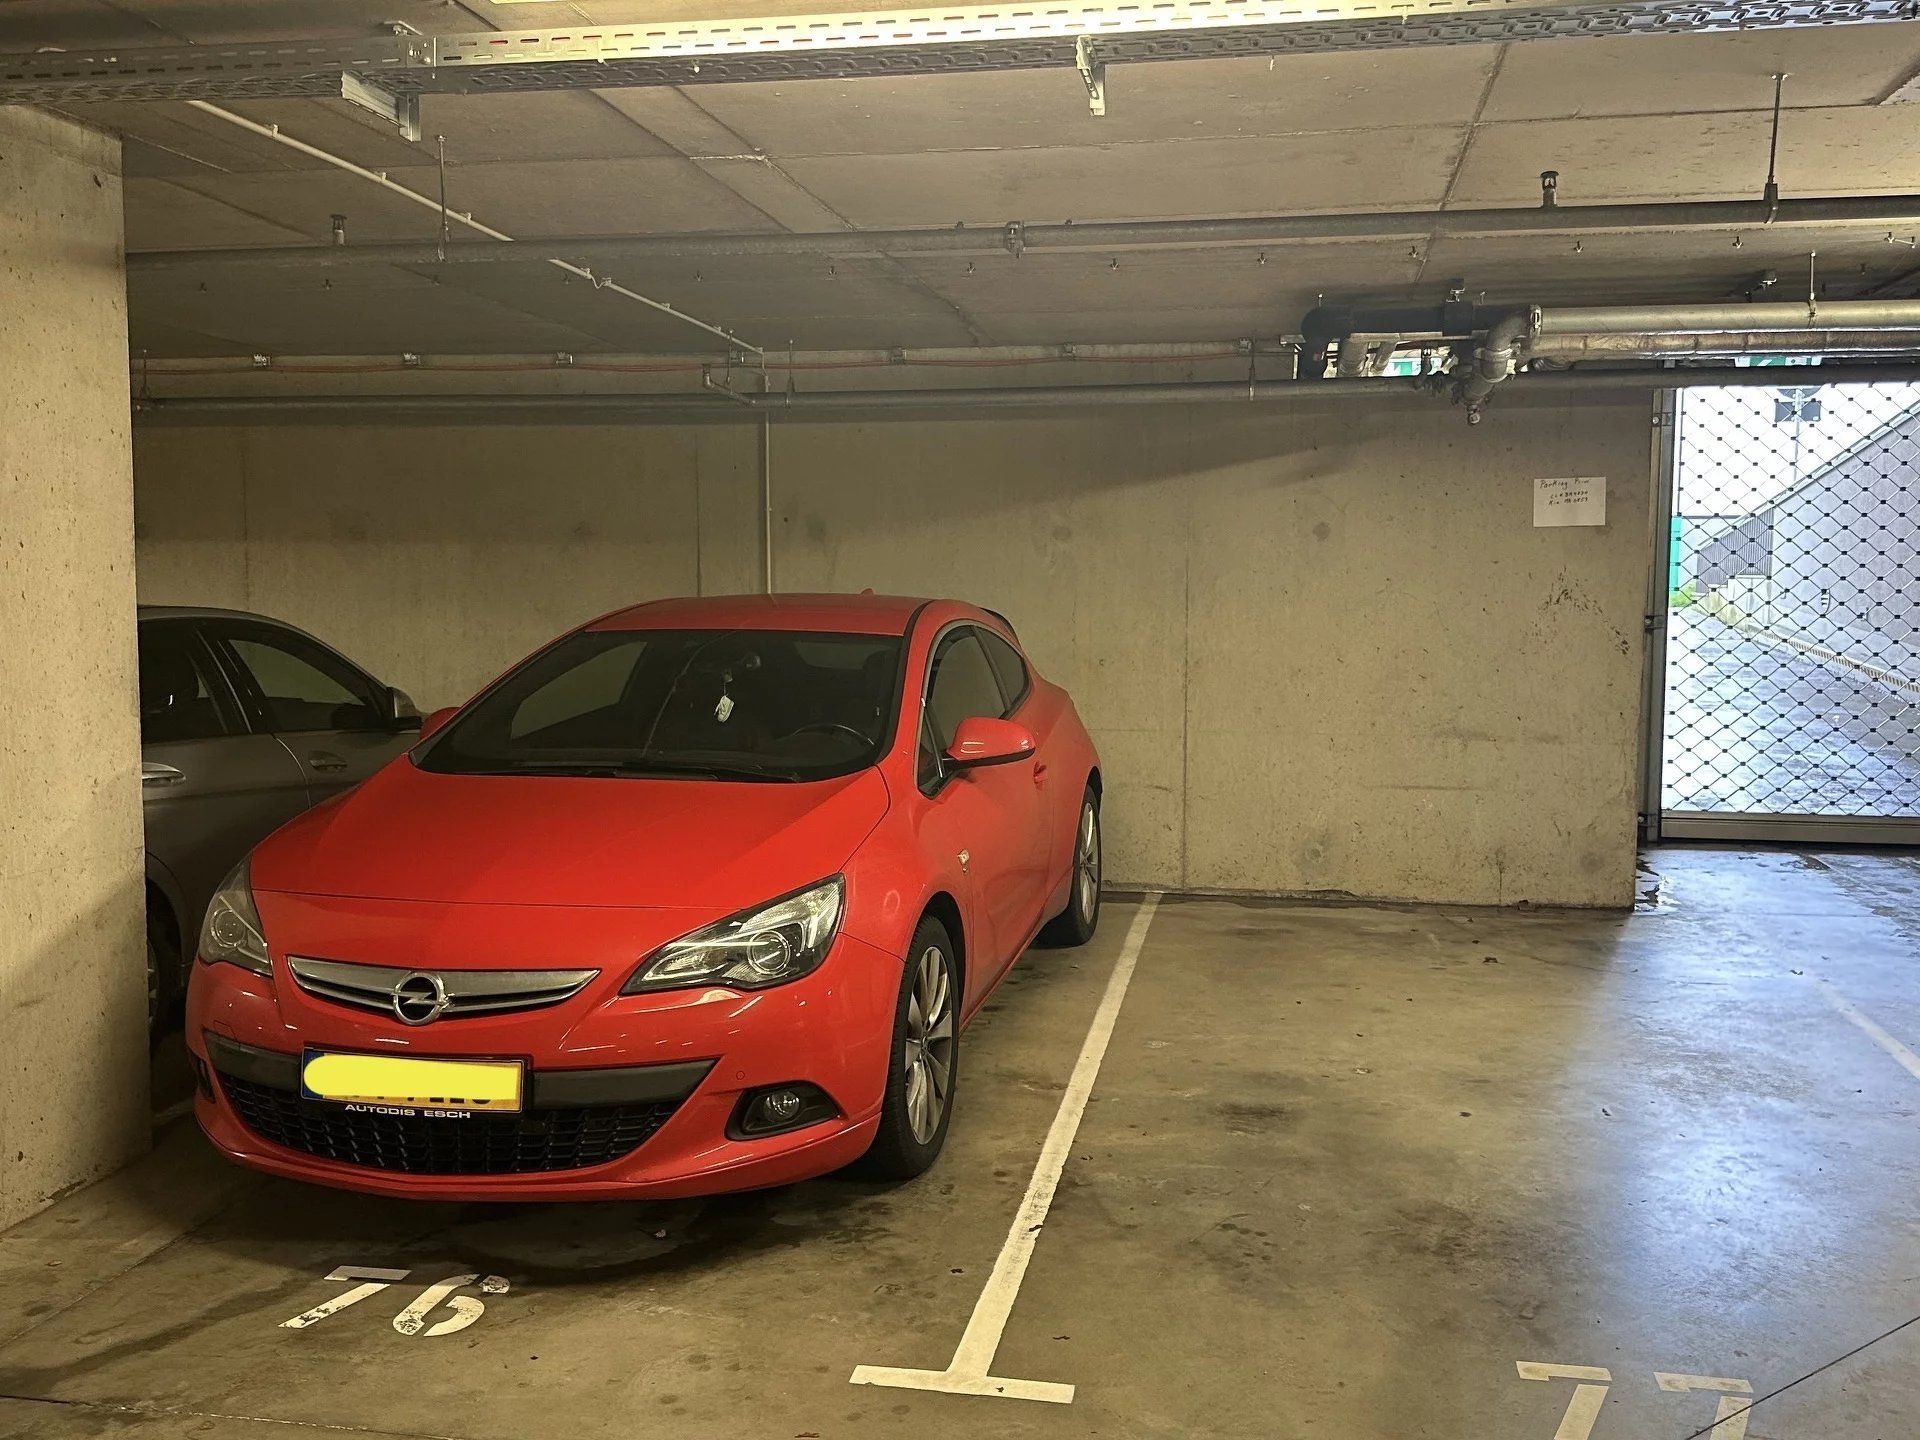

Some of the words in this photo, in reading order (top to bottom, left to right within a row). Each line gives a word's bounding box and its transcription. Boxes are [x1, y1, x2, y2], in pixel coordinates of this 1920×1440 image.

[1540, 480, 1568, 490] Parking
[344, 1104, 416, 1116] AUTODIS
[423, 1110, 471, 1119] ESCH
[277, 1265, 511, 1337] 76
[1515, 1360, 1755, 1440] 77
